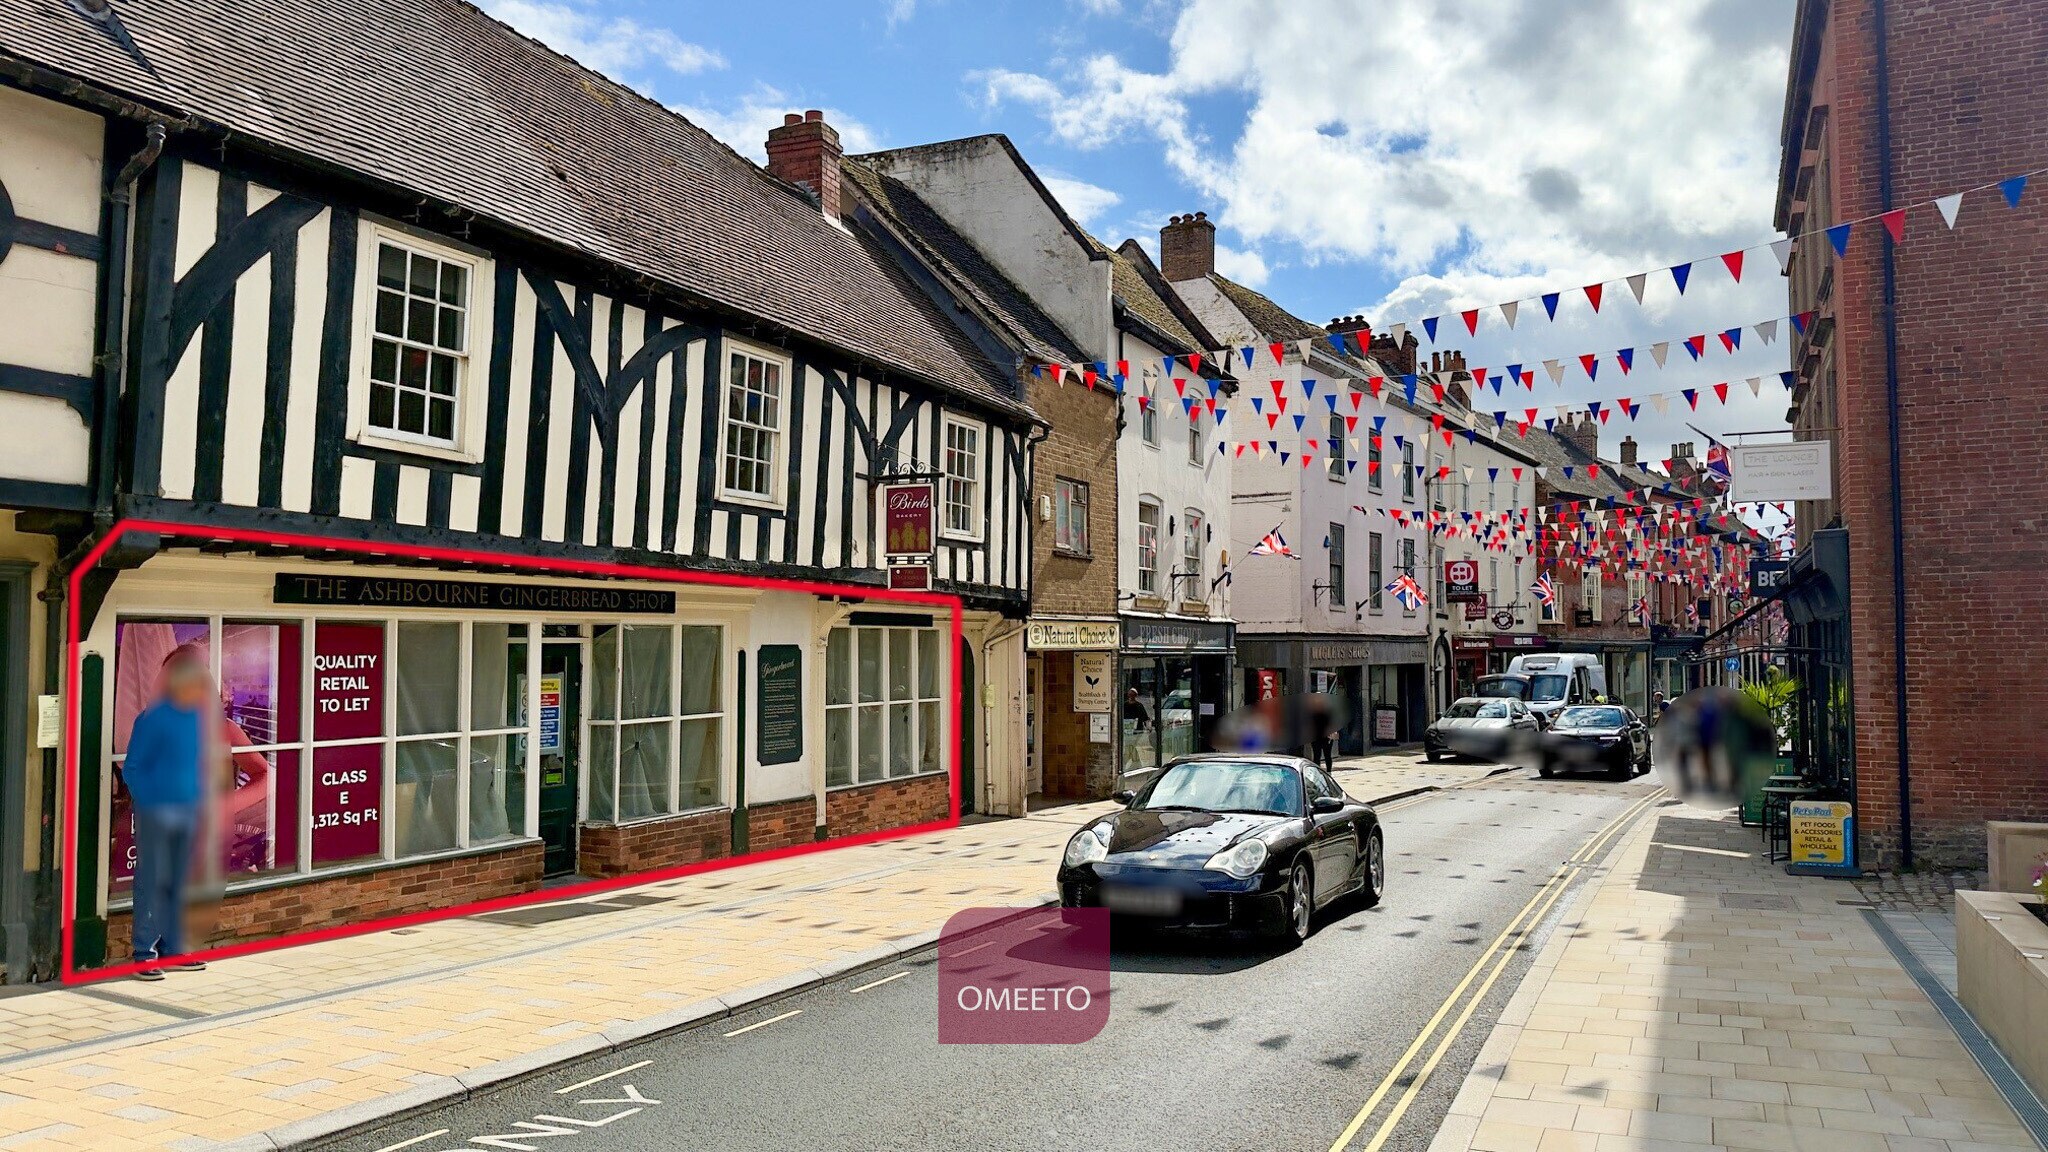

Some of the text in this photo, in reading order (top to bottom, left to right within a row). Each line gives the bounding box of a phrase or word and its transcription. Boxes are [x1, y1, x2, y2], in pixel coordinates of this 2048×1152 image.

[890, 492, 929, 510] Birds
[295, 577, 668, 611] THE ASHBOURNE GINGERBREAD SHOP
[1044, 625, 1078, 645] Natural
[1080, 627, 1107, 644] Choice
[1139, 625, 1202, 644] FRESH CHOICE
[314, 655, 377, 671] QUALITY
[1082, 665, 1103, 673] Choice
[320, 676, 370, 691] RETAIL
[320, 697, 370, 713] TO LET
[322, 769, 367, 786] CLASS
[340, 791, 349, 804] E
[343, 811, 360, 825] Sq
[364, 808, 377, 821] Ft
[440, 1084, 662, 1152] NLY
